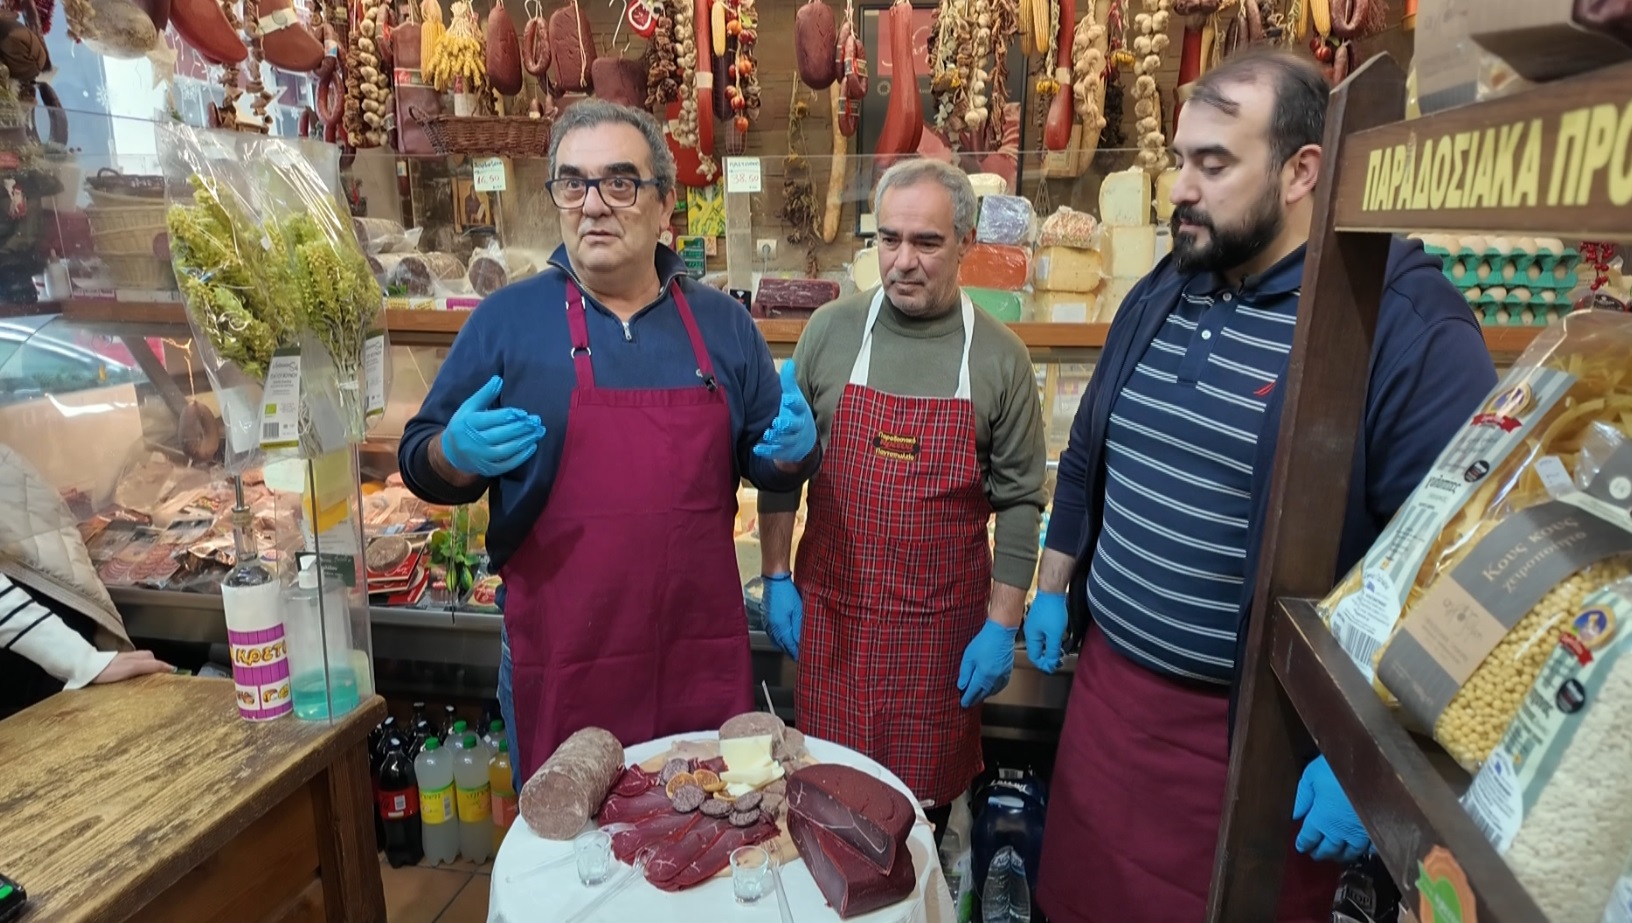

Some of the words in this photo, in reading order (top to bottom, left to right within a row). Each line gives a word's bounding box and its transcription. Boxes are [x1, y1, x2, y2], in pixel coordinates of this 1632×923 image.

[1362, 118, 1543, 211] ΠΑΡΑΔΟΣΙΑΚΑ
[1482, 541, 1528, 582] Κους
[1528, 516, 1580, 544] κους
